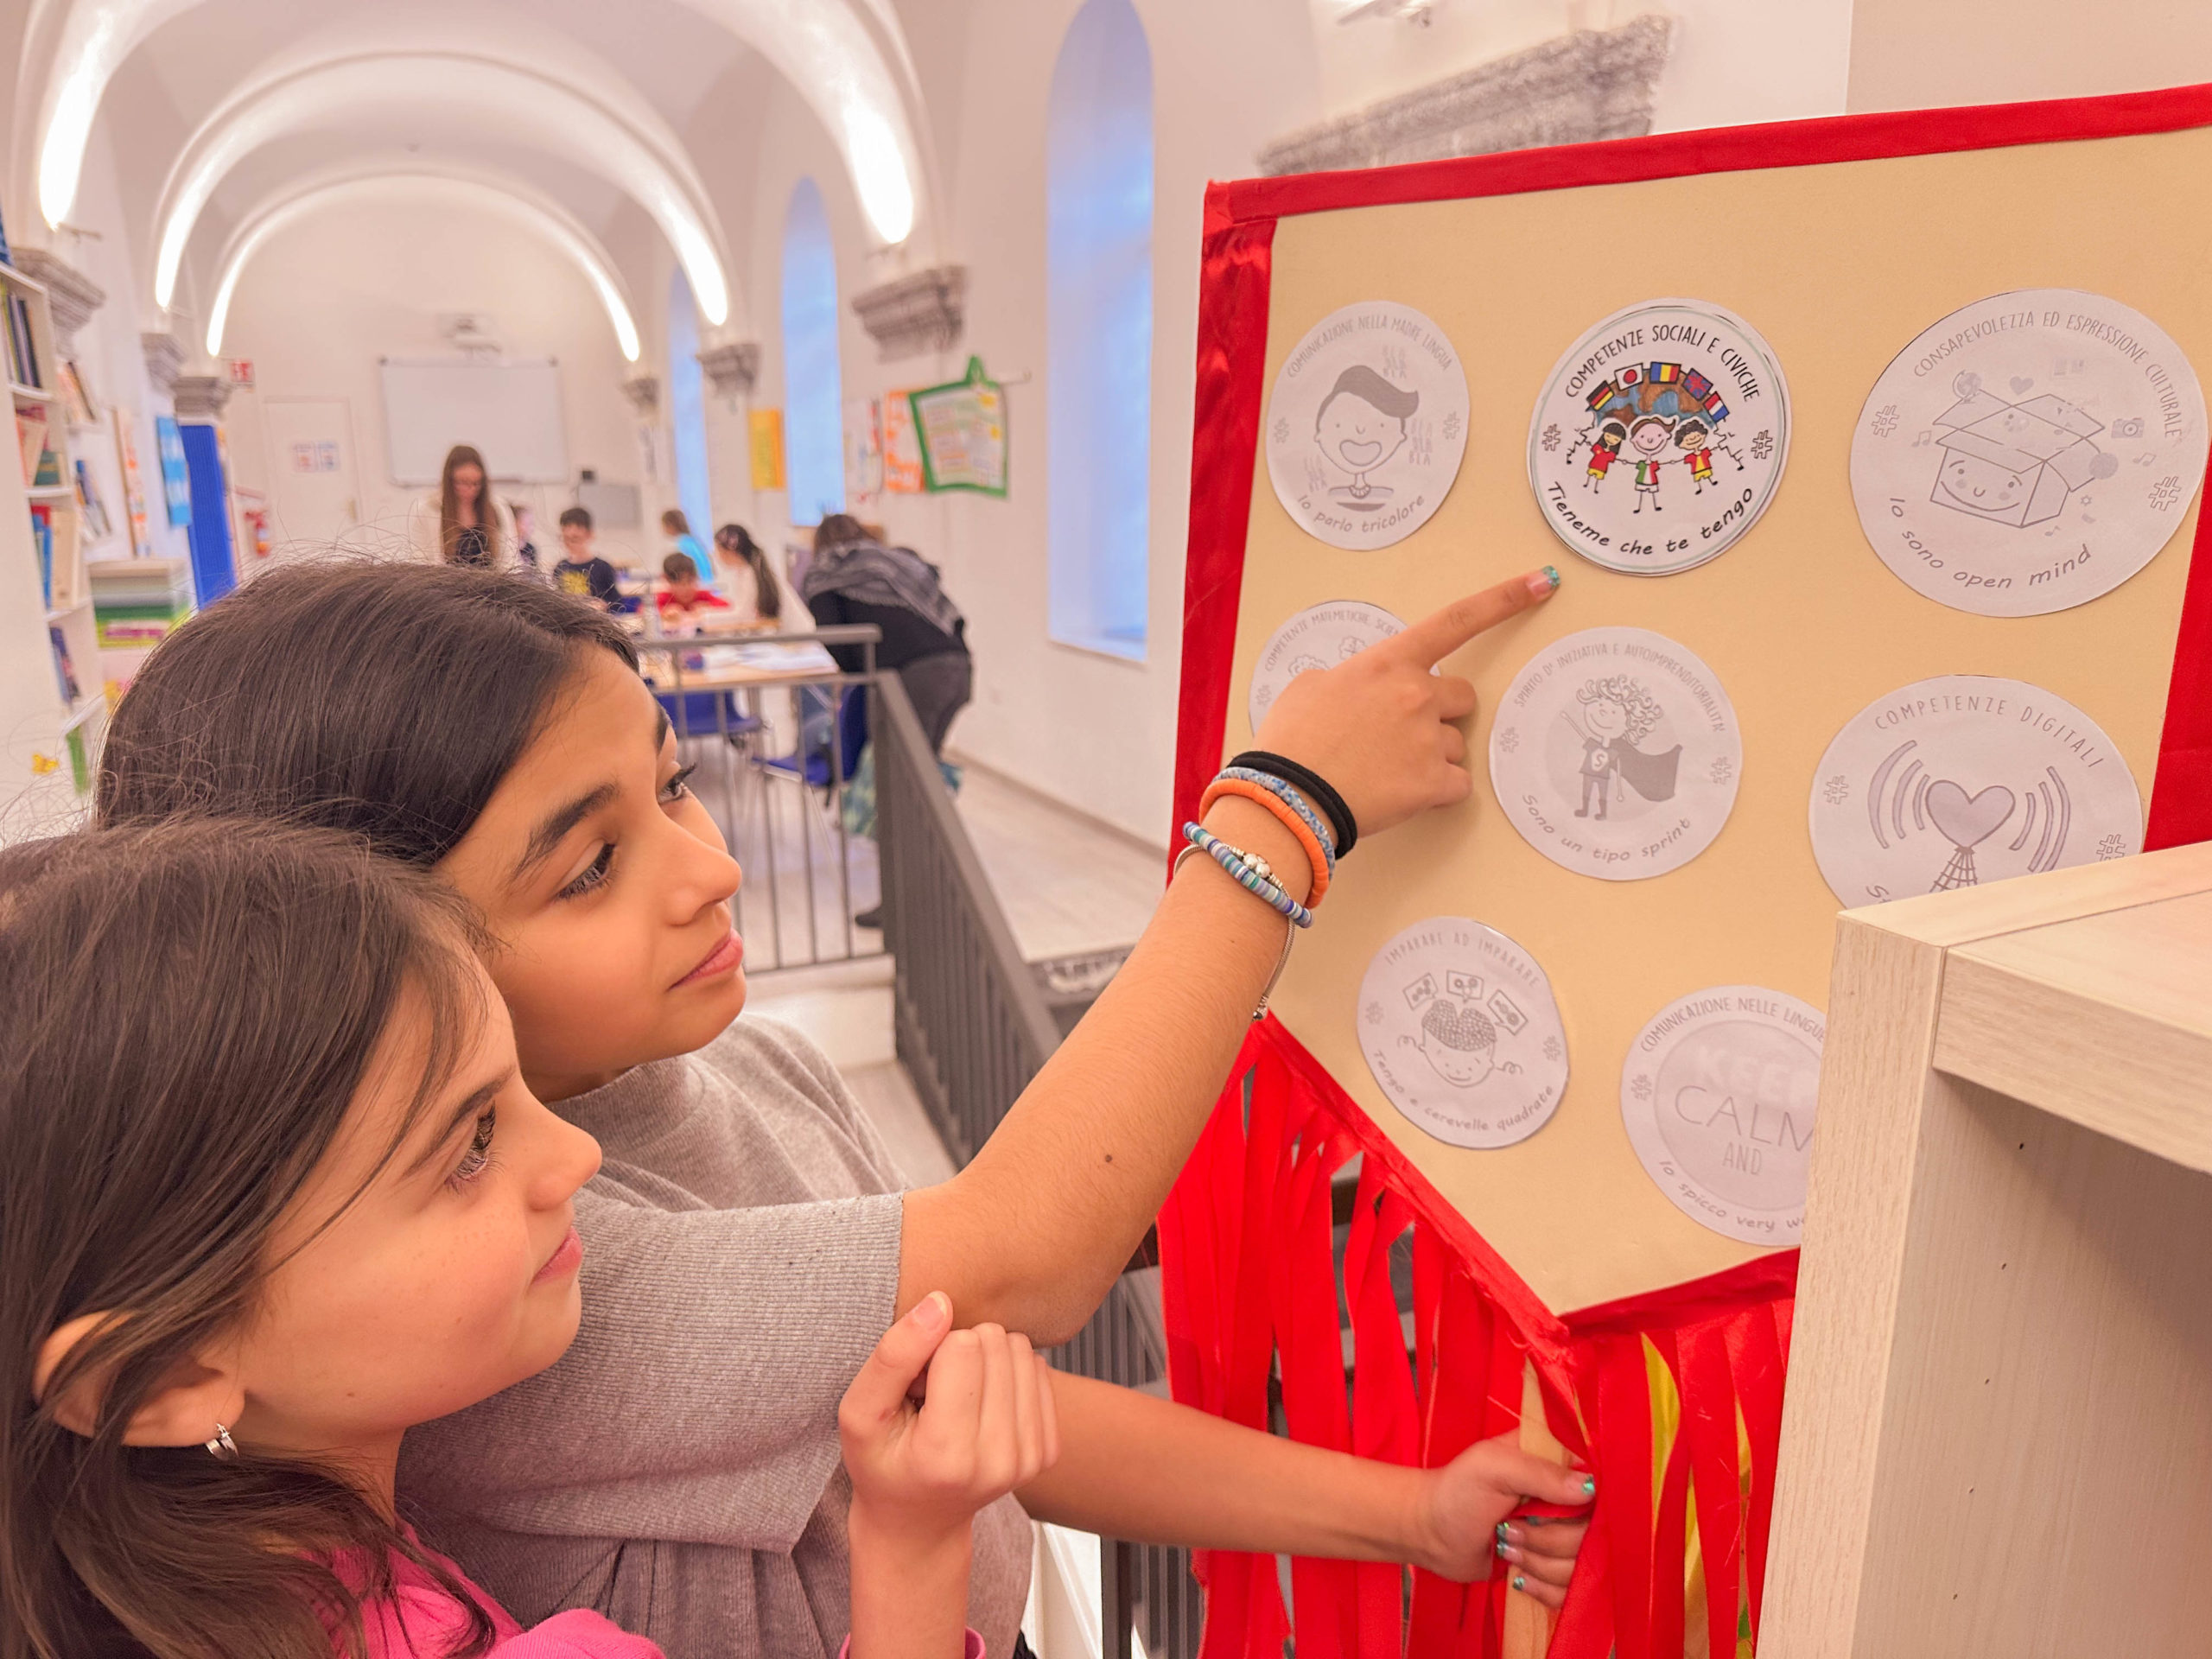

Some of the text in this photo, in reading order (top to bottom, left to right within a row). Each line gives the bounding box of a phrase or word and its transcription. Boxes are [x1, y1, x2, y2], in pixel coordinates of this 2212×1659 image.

[1287, 315, 1452, 378] COMUNICAZIONE NELLA MADRE LINGUA
[1566, 324, 1760, 403] COMPETENZE SOCIALI E CIVICHE
[1913, 310, 2183, 439] CONSAPEVOLEZZA ED ESPRESSIONE CULTURALE
[1313, 512, 1352, 532] parlo
[1362, 495, 1425, 532] tricolore
[1548, 481, 1753, 555] Tieneme che te tengo
[1902, 529, 1944, 569] sono
[1953, 569, 2012, 589] open
[2029, 543, 2091, 587] mind
[1514, 672, 1542, 708] SPIRITO
[1556, 643, 1608, 668] INIZIATIVA
[1613, 644, 1619, 656] E
[1595, 752, 1605, 768] S
[1874, 695, 2105, 768] COMPETENZE DIGITALI
[1522, 794, 1691, 864] Sono un tipo sprint
[1384, 931, 1540, 988] IMPARARE AD IMPARARE
[1641, 996, 1732, 1053] COMUNICAZIONE
[1738, 997, 1779, 1018] NELLE
[1374, 1051, 1405, 1094] Tengo
[1497, 1085, 1554, 1131] quadrate
[1722, 1141, 1762, 1176] AND
[1679, 1183, 1727, 1217] spicco
[1737, 1216, 1776, 1233] very
